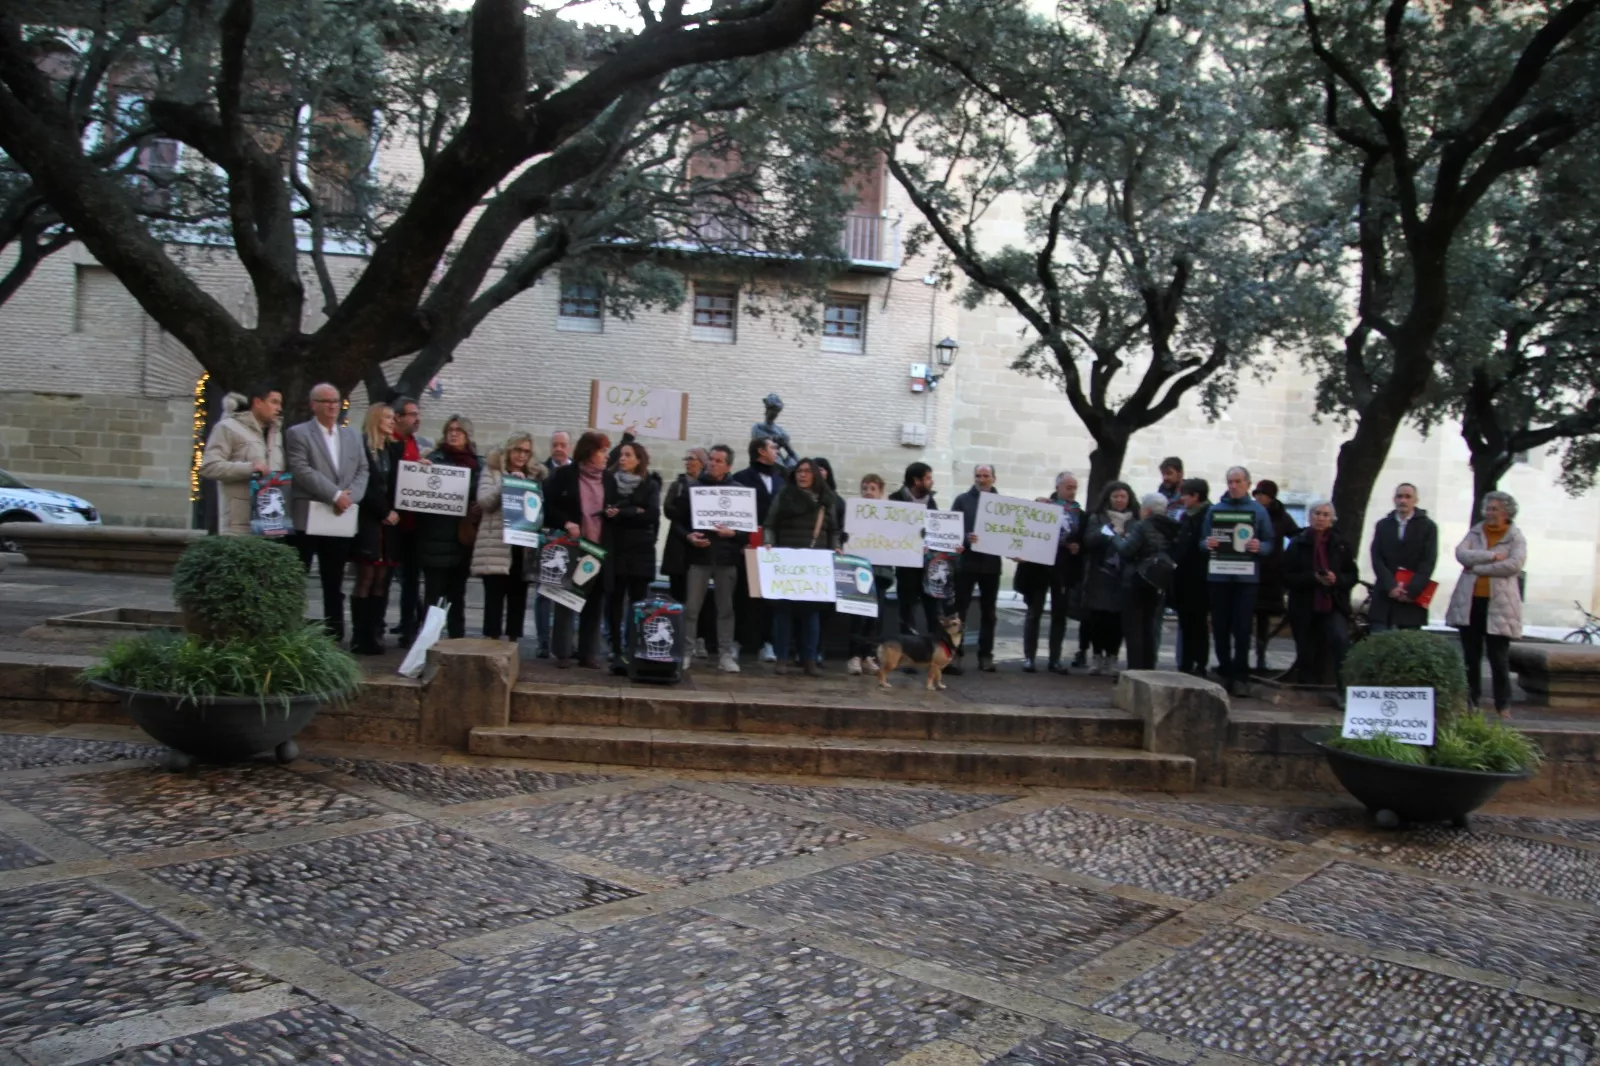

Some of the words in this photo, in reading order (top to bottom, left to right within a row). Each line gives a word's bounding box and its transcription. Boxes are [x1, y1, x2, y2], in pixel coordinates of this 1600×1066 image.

[403, 464, 418, 473] NO
[419, 467, 429, 475] AL
[431, 467, 467, 479] RECORTE
[401, 487, 465, 502] COOPERACIÓN
[695, 489, 707, 497] NO
[720, 489, 752, 497] RECORTE
[401, 500, 410, 508] AL
[411, 501, 464, 513] DESARROLLO
[856, 504, 880, 519] POR
[773, 565, 831, 577] RECORTES
[770, 579, 829, 595] MATAN
[1352, 690, 1368, 699] NO
[1369, 690, 1380, 699] AL
[1382, 690, 1428, 700] RECORTE
[1349, 716, 1428, 728] COOPERACIÓN
